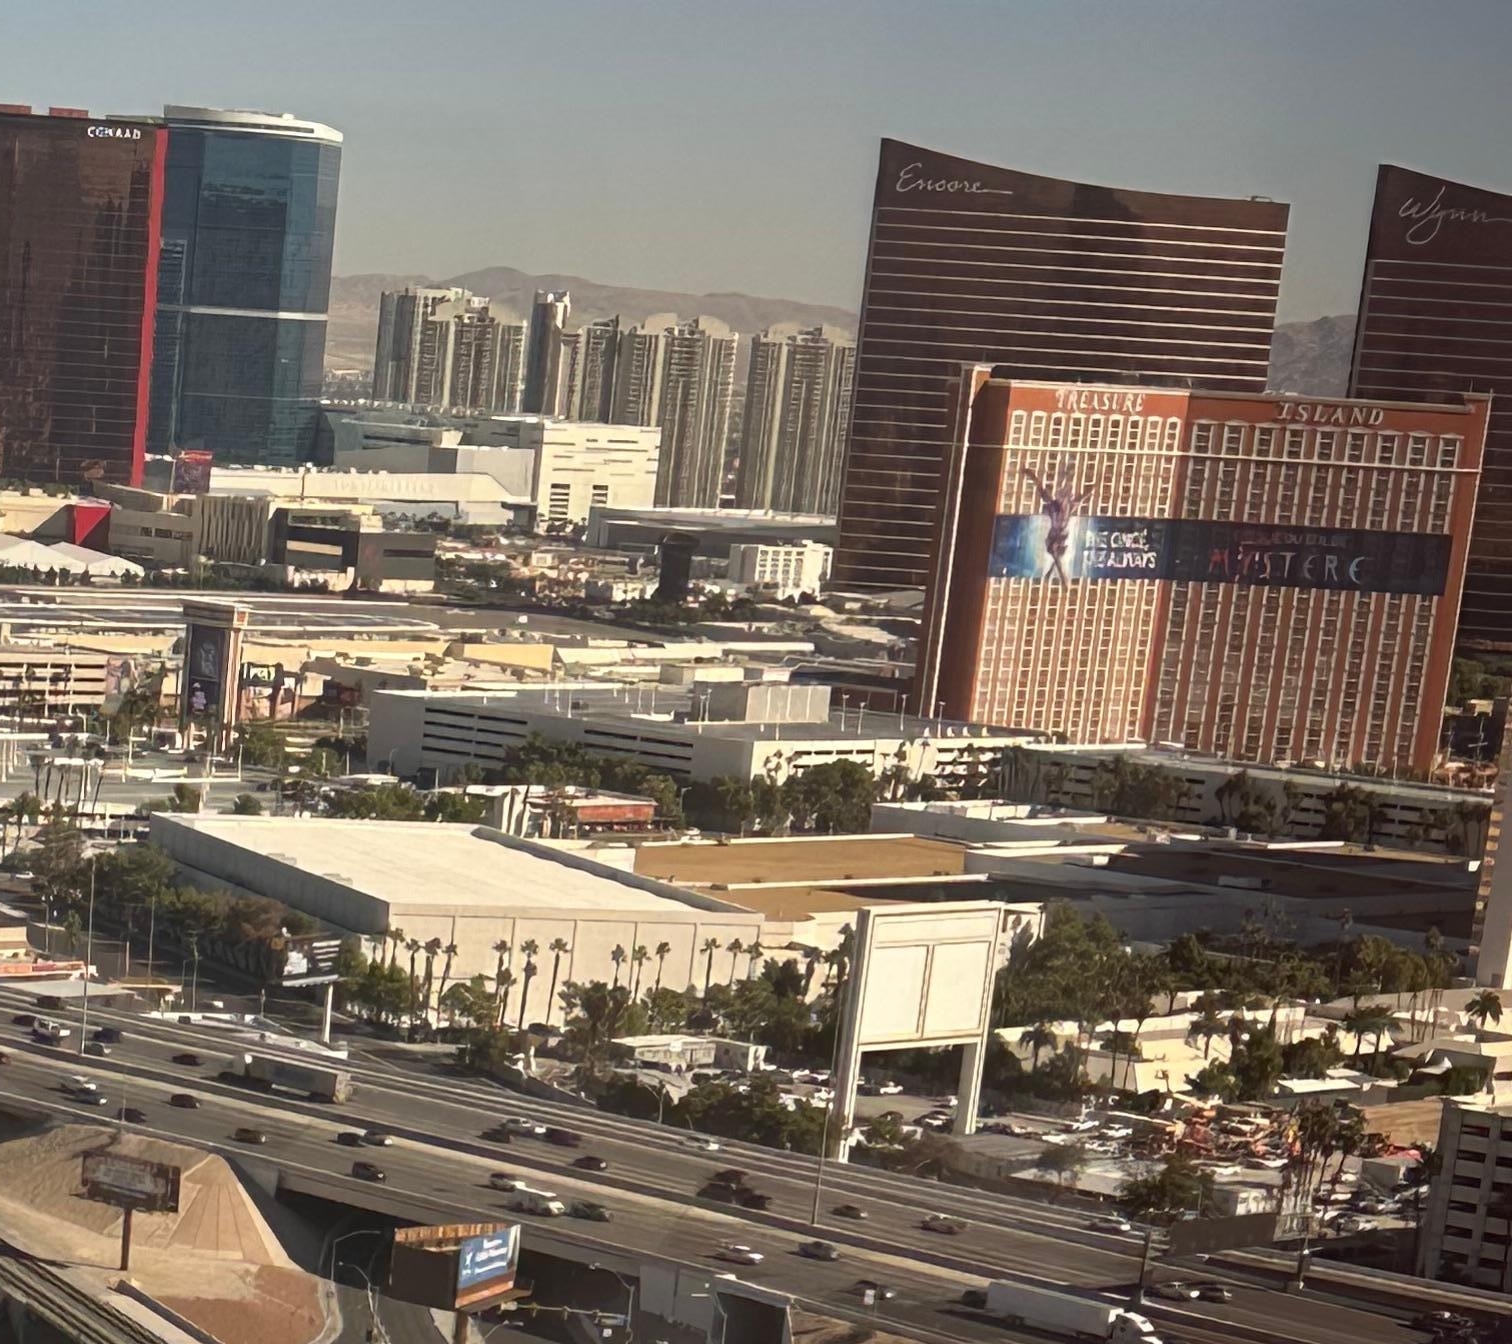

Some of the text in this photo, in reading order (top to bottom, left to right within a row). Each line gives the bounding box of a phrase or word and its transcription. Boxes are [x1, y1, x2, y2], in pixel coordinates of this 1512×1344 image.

[896, 162, 1013, 194] Encore
[1398, 186, 1512, 245] Wynn
[1055, 387, 1384, 425] TREASURE ISLAND
